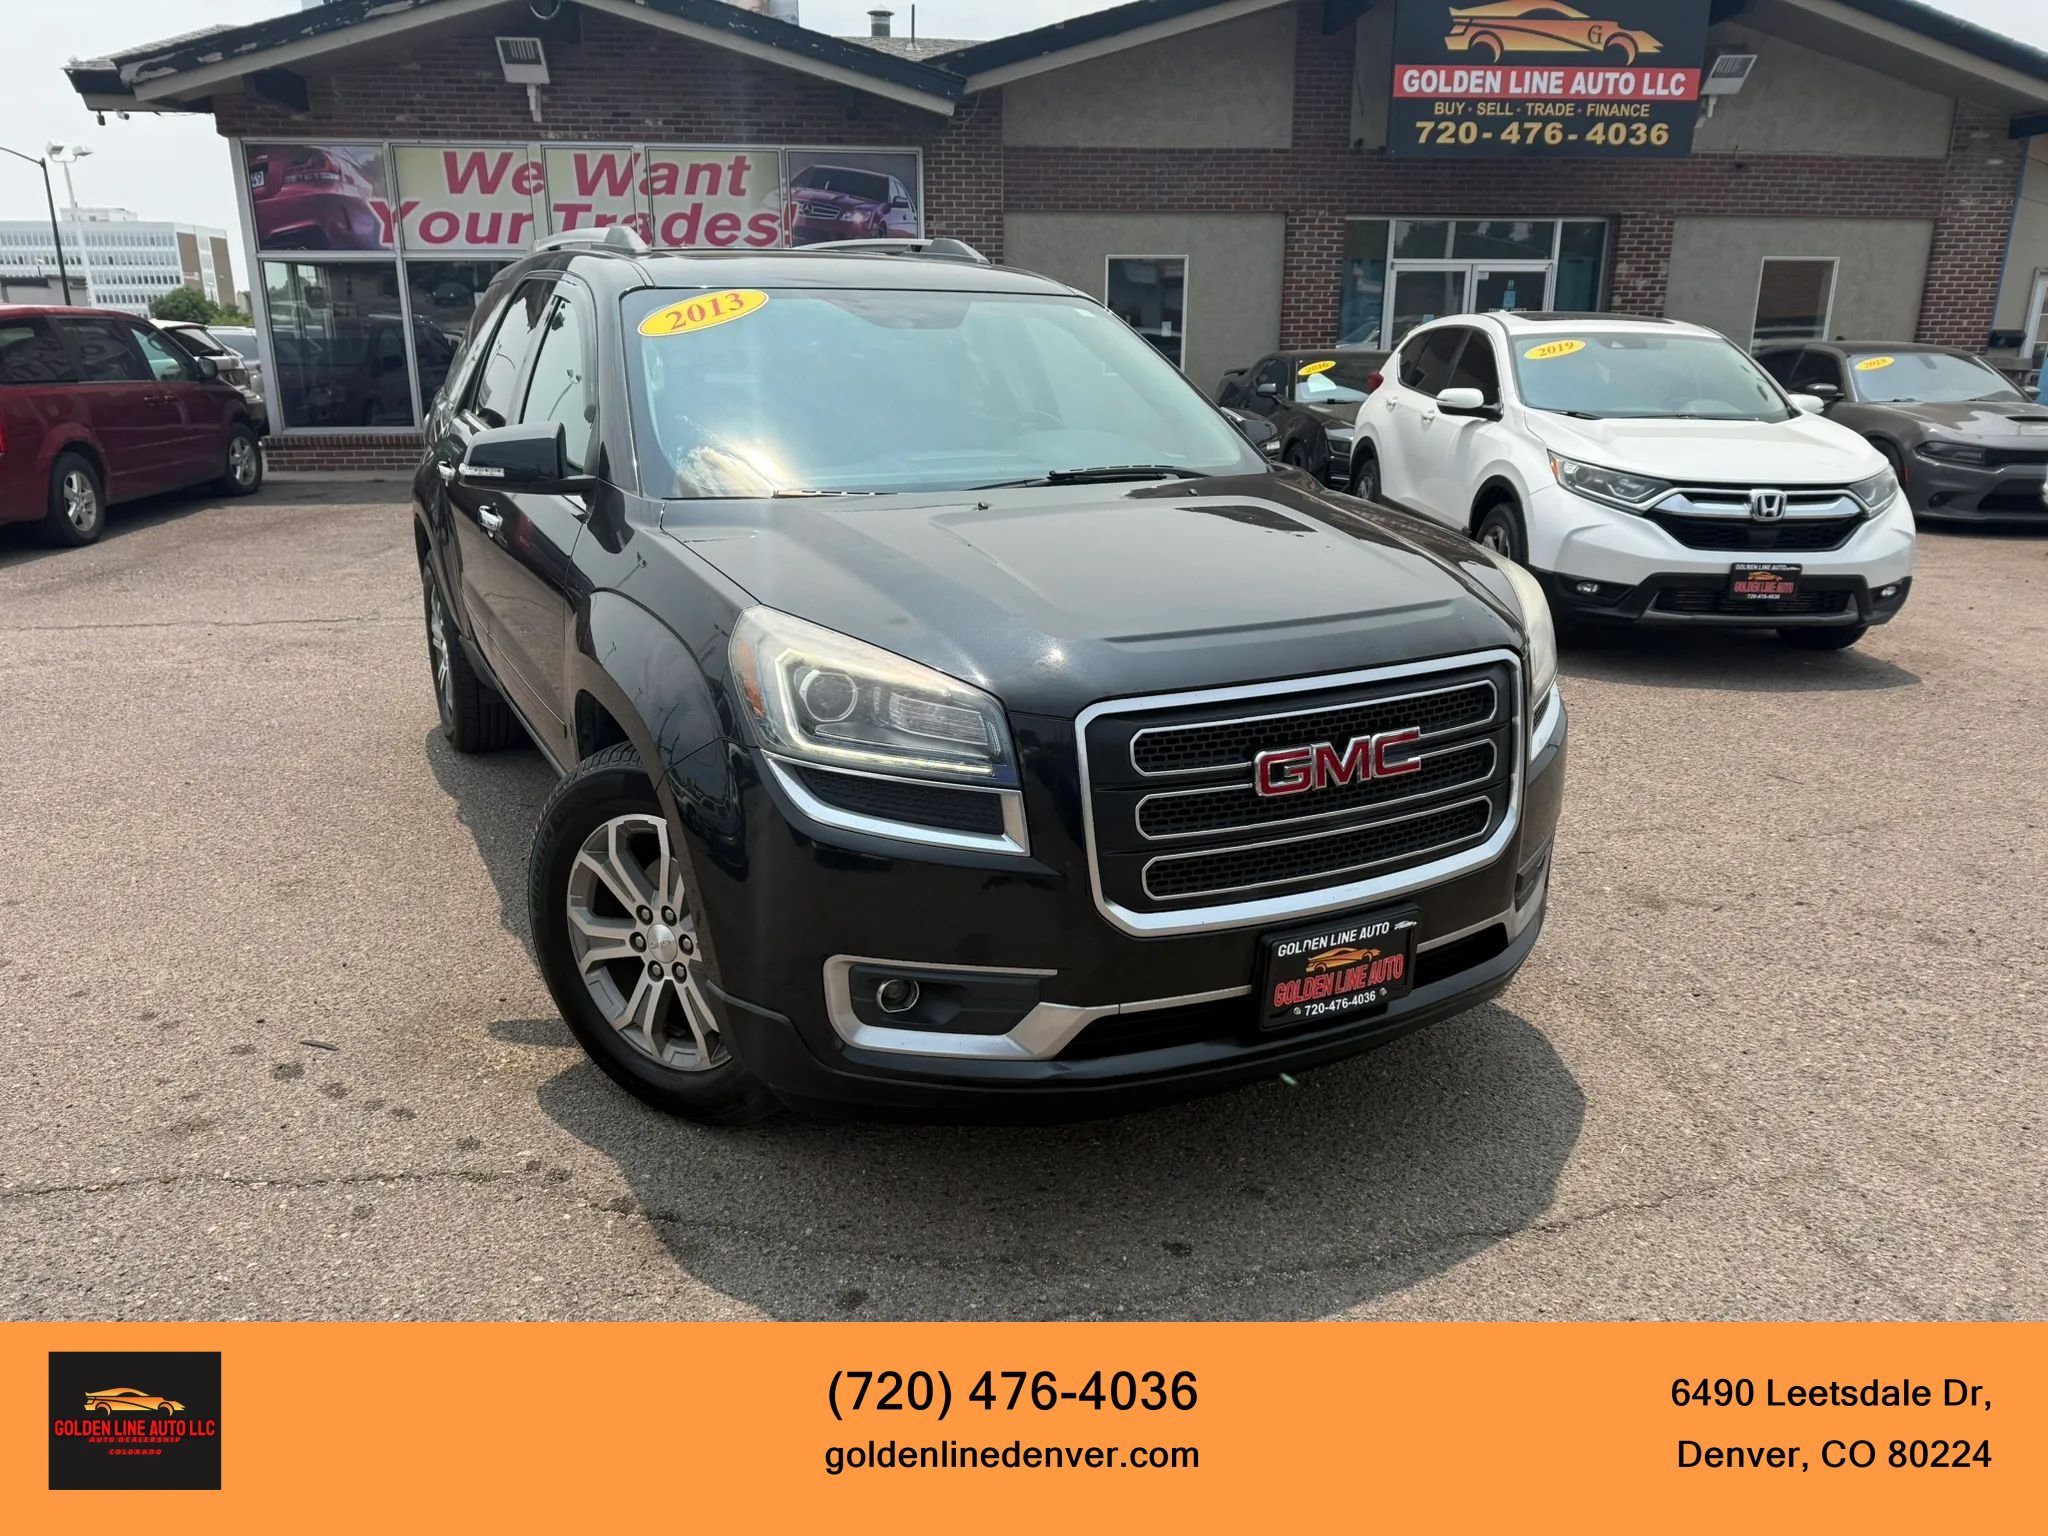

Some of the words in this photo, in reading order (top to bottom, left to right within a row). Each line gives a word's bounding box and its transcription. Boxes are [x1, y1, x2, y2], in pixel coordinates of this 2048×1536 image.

[1587, 25, 1603, 44] G
[1402, 70, 1502, 94] GOLDEN
[1509, 72, 1563, 94] LINE
[1570, 73, 1636, 95] AUTO
[1642, 75, 1686, 96] LLC
[1434, 102, 1465, 115] BUY
[1477, 103, 1514, 116] SELL
[1526, 104, 1575, 117] TRADE
[1586, 104, 1650, 118] FINANCE
[443, 151, 545, 196] We
[573, 153, 751, 197] Want
[369, 201, 534, 244] Your
[665, 293, 744, 330] 2013
[1538, 342, 1574, 356] 2019
[1255, 726, 1421, 796] GMC
[1278, 936, 1327, 957] GOLDEN
[1330, 930, 1357, 947] LINE
[1359, 921, 1390, 940] AUTO
[1273, 971, 1335, 1008] GOLDEN
[1335, 964, 1368, 993] LINE
[1368, 954, 1404, 986] AUTO
[1305, 990, 1376, 1016] 720-476-4036
